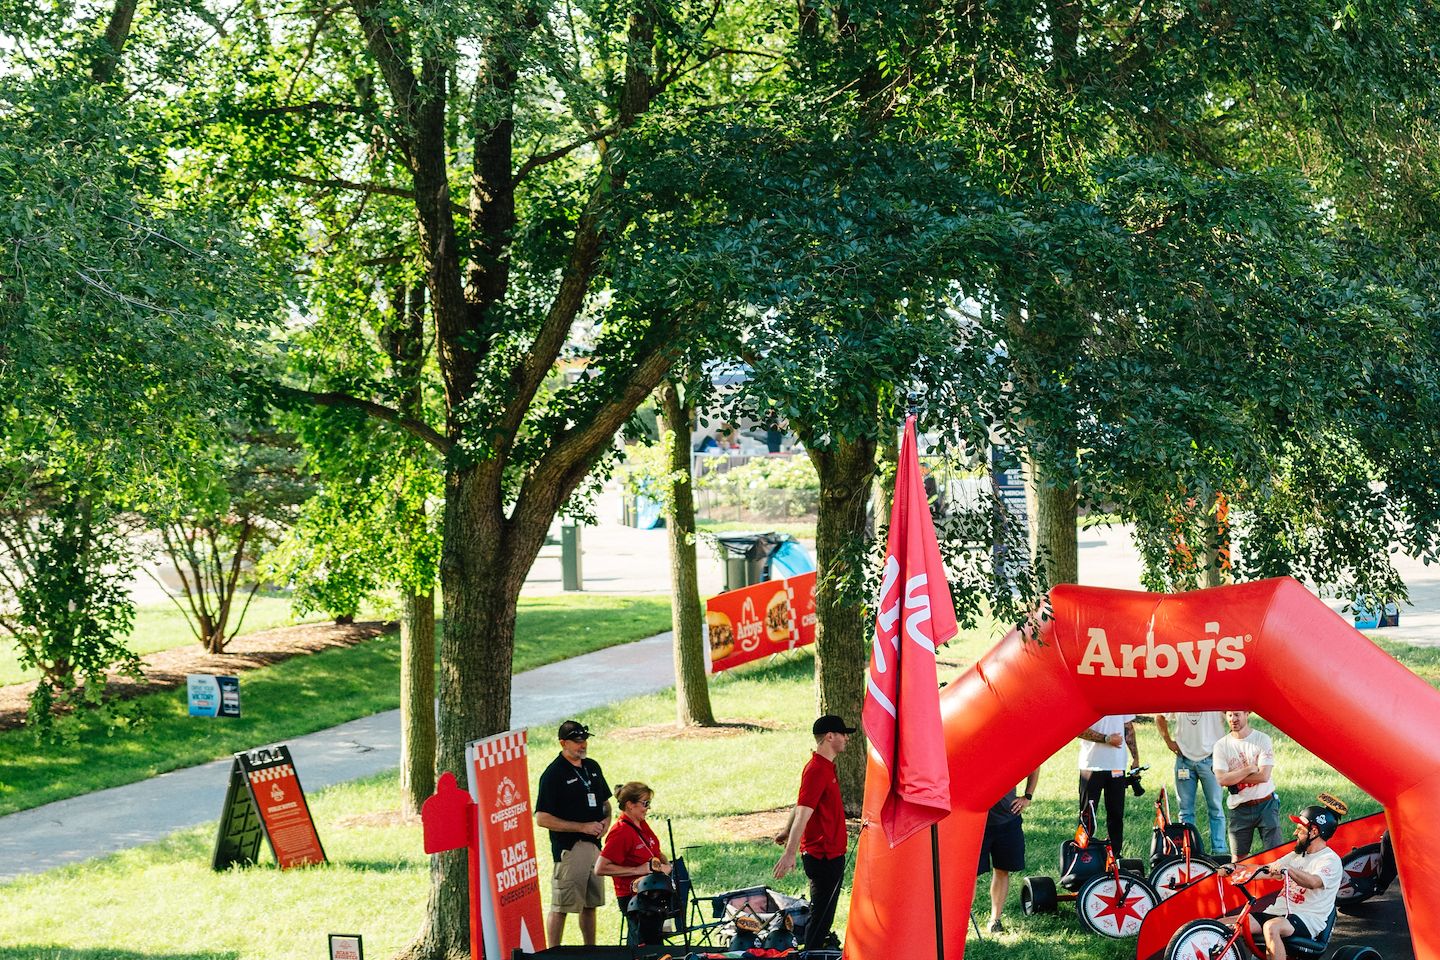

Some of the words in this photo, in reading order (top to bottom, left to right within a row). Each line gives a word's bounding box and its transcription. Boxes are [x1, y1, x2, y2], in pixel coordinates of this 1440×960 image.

[1077, 621, 1247, 688] Arby's
[503, 817, 519, 832] RACE
[501, 840, 528, 869] RACE
[496, 866, 518, 893] FOR
[516, 857, 537, 883] THE
